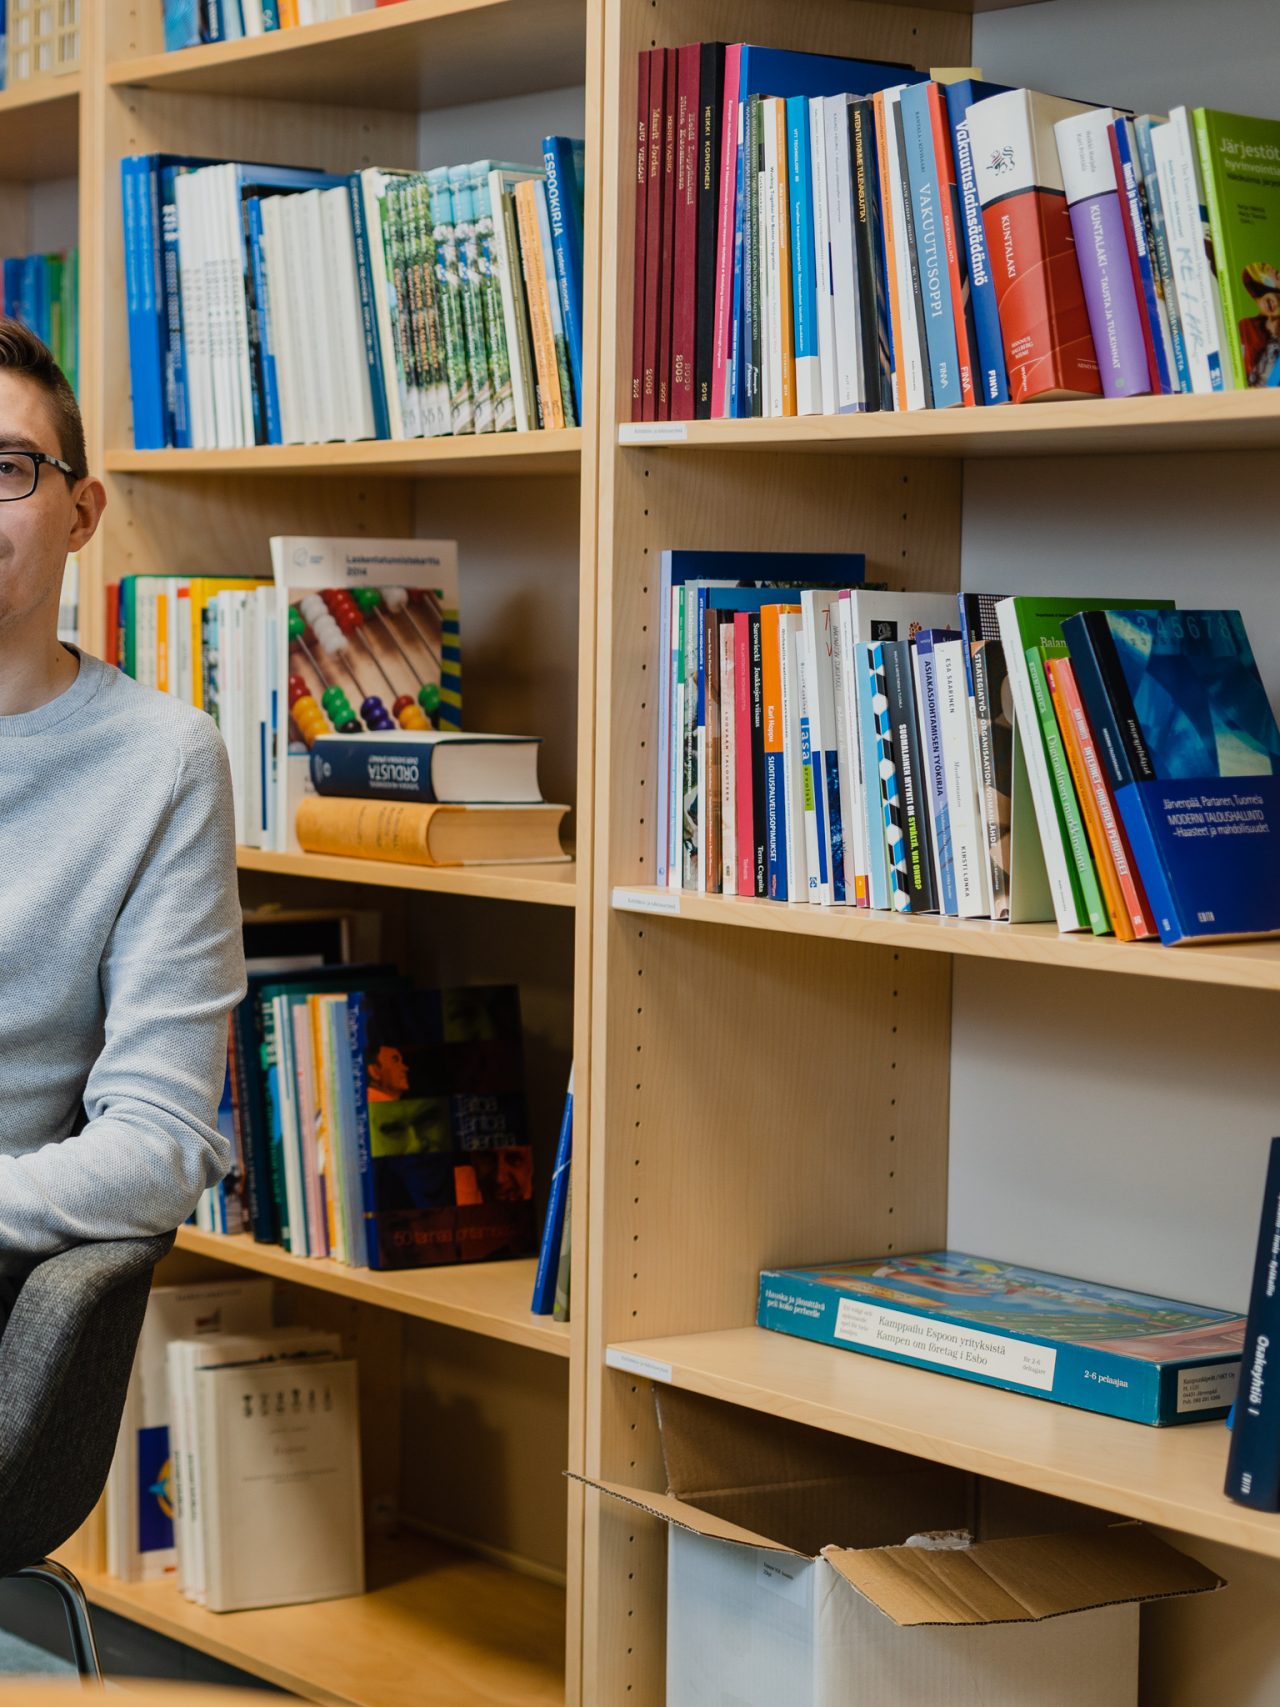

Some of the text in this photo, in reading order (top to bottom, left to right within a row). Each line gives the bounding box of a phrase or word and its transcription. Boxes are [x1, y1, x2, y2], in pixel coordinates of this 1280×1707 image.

[854, 111, 862, 132] MITEN
[703, 106, 712, 190] HEIKKI KORHONEN
[855, 132, 864, 167] TUTKIMME
[543, 152, 563, 237] ESPOOKIRJA
[956, 121, 985, 286] Vakuutuslainsäädäntö
[920, 182, 943, 317] VAKUUTUSOPPI
[1001, 215, 1017, 279] KUNTALAKI
[1089, 204, 1121, 369] KUNTALAKI TAUSTA JA TULKINNAT
[989, 370, 998, 399] FINVA
[753, 622, 761, 662] Surowiecki
[753, 666, 761, 702] Joukkojen
[947, 675, 956, 714] SAARINEN
[974, 653, 987, 712] STRATEGIATYÖ
[767, 720, 775, 742] Hoppu
[924, 660, 944, 796] ASIAKASJOHTAMISEN TYÖKIRJA
[1127, 719, 1152, 776] yritysjulkaisut
[980, 719, 993, 785] ORGANISAATION
[898, 723, 923, 890] SUOMALAINEN MYYNTI ON SYVÄLTÄ, VAI ONKO?
[984, 787, 997, 848] VOIMANLÄHDE
[1047, 735, 1087, 873] Digitaalinen markkinointi
[1163, 797, 1203, 810] Järvenpää,
[1201, 795, 1235, 807] Partanen,
[1167, 810, 1265, 825] MODERNI TALOUSHALLINTO
[1209, 827, 1217, 837] ja
[1217, 823, 1270, 835] mahdollisuudet
[757, 865, 765, 893] Cognita
[960, 845, 971, 897] KIRSTI LONKA
[765, 1288, 788, 1301] Hauska
[788, 1294, 795, 1305] ja
[766, 1299, 778, 1310] peli
[793, 1304, 821, 1318] perheelle
[876, 1329, 911, 1348] Kampen
[912, 1340, 926, 1351] om
[927, 1341, 958, 1359] företag
[965, 1350, 988, 1366] Esbo
[878, 1314, 924, 1338] Kamppailu
[926, 1326, 958, 1345] Espoon
[958, 1334, 1006, 1357] yrityksistä
[1084, 1370, 1129, 1388] 2-6 pelaajaa
[1248, 1334, 1270, 1404] Osakeyhtiö
